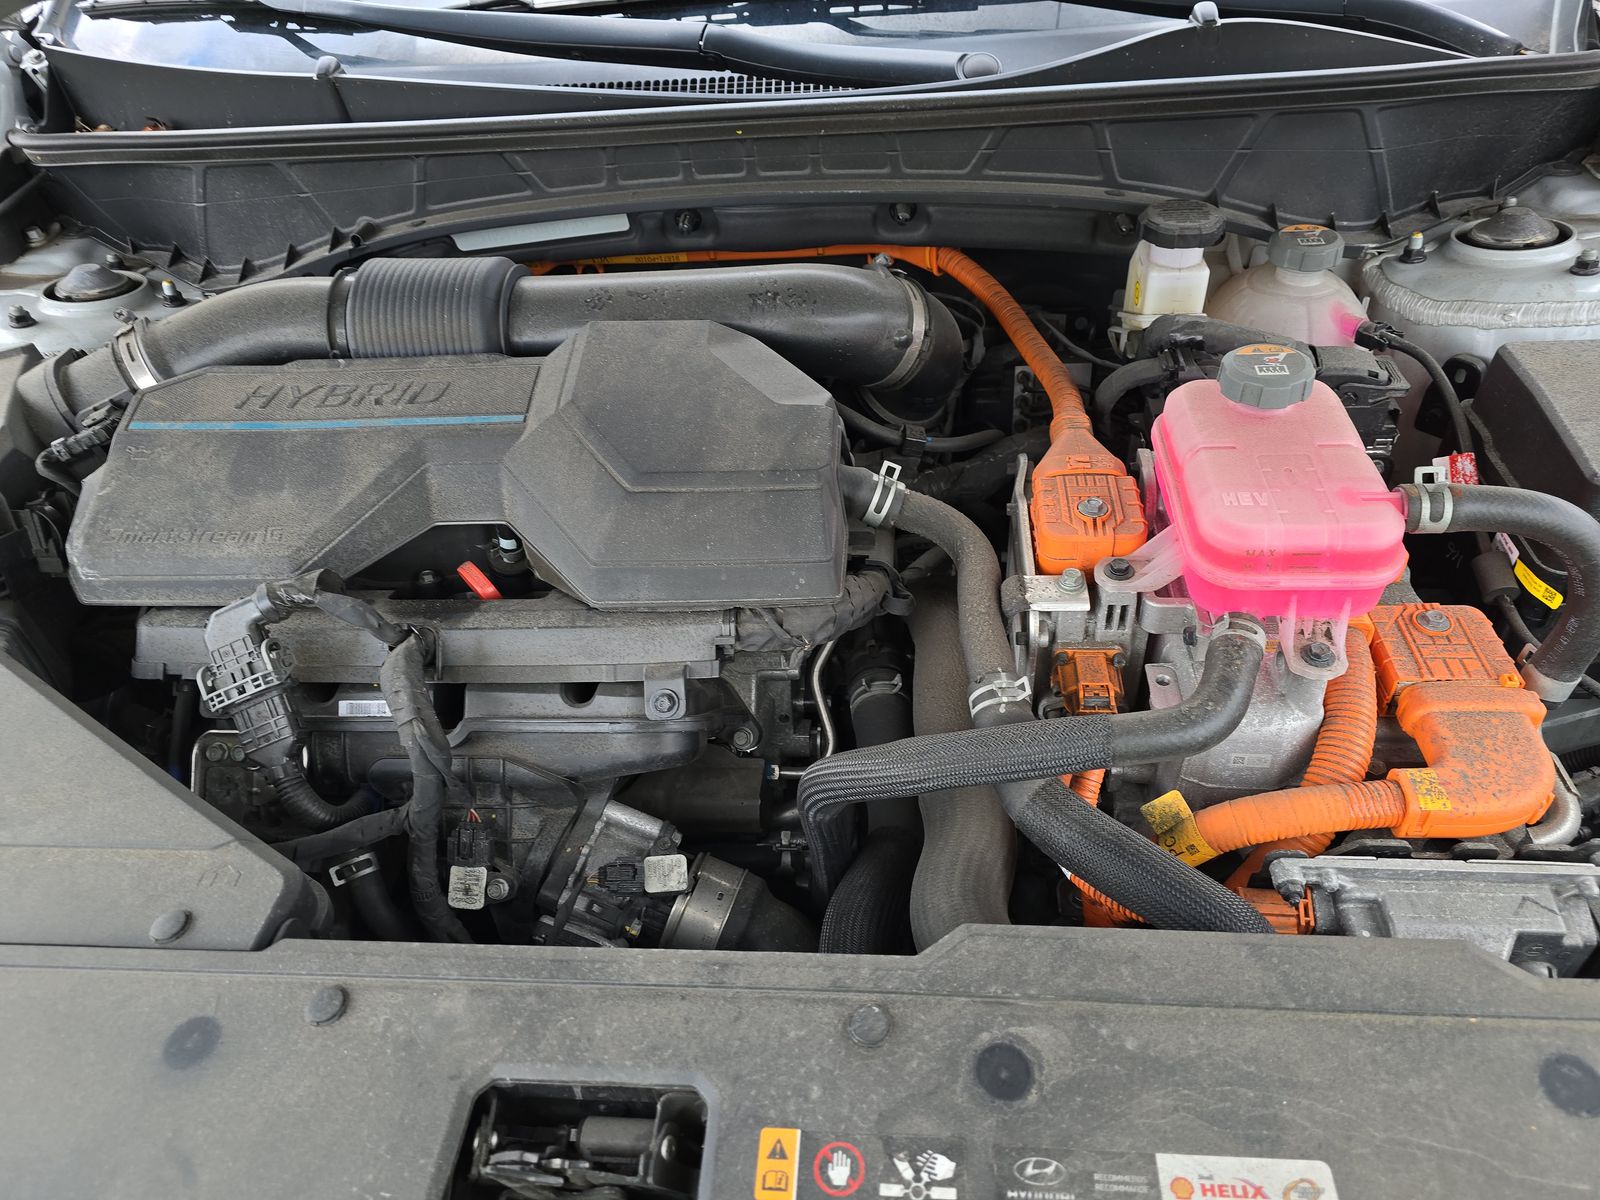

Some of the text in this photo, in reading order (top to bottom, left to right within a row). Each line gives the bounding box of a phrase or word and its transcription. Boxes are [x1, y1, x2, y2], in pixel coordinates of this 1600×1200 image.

[234, 381, 451, 410] HYBRID
[1222, 491, 1269, 507] HEV
[103, 527, 260, 545] Smartstream
[1245, 548, 1277, 557] MAX
[1244, 563, 1273, 571] MN
[1200, 1183, 1269, 1199] HELIX
